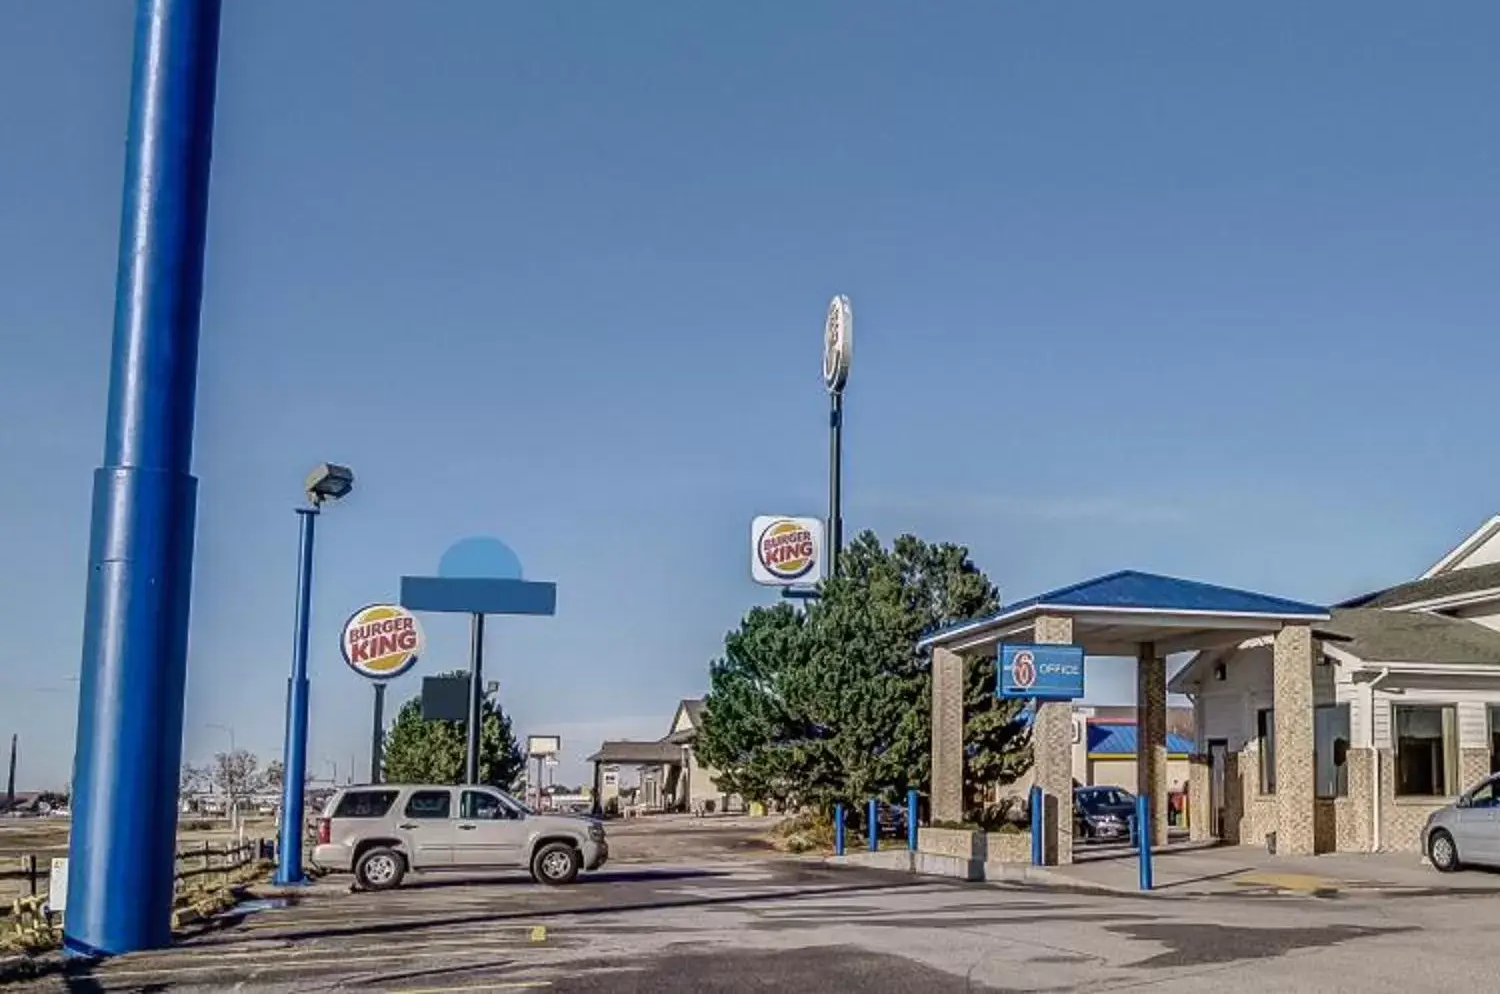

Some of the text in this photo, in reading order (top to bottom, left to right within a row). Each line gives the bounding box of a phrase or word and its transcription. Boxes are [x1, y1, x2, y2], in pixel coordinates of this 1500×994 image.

[764, 531, 811, 551] BURGER
[766, 542, 812, 566] KING
[350, 617, 413, 644] BURGER
[351, 630, 417, 663] KING
[1012, 649, 1080, 688] 6 OFFICE
